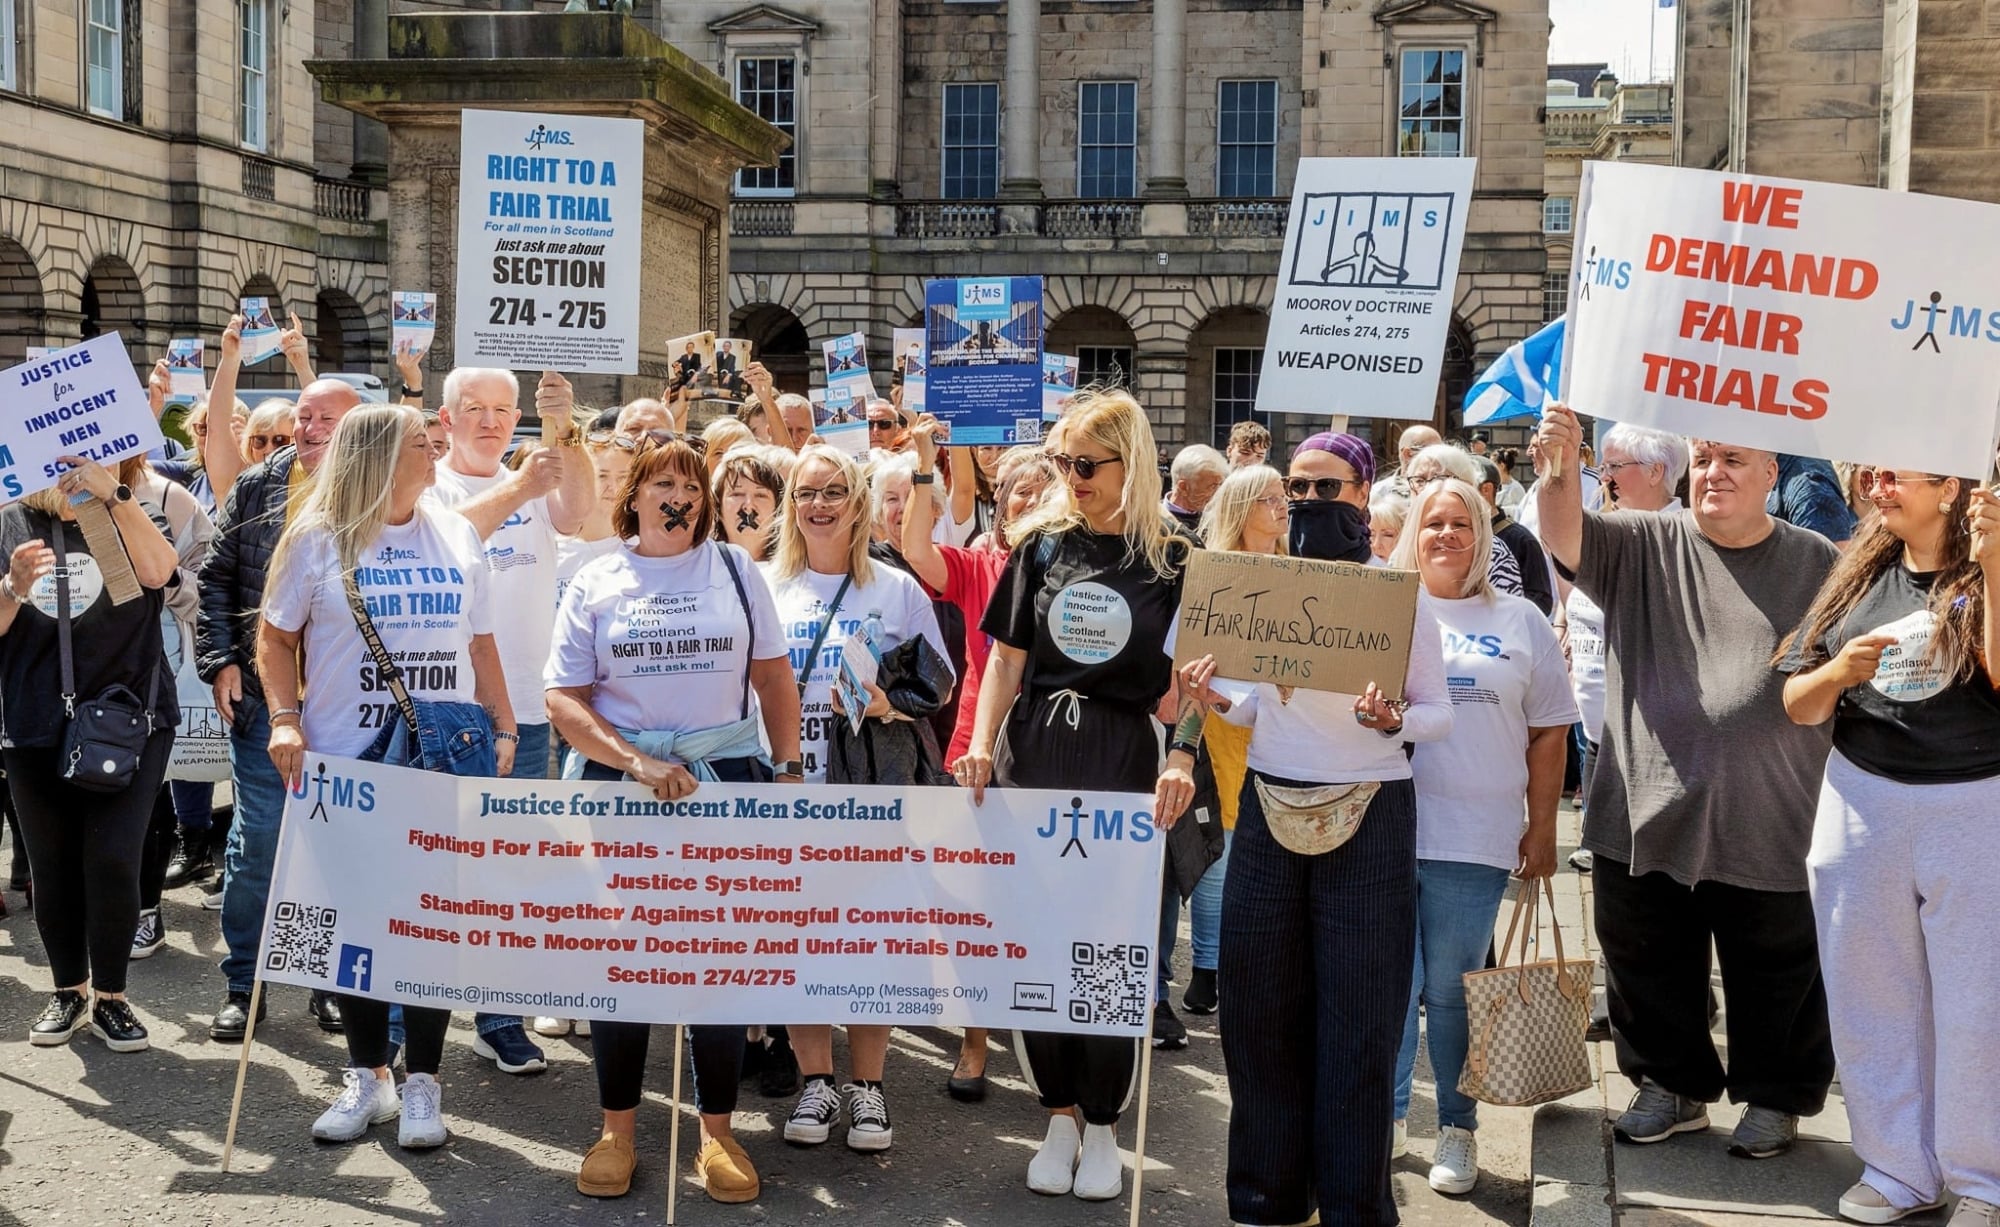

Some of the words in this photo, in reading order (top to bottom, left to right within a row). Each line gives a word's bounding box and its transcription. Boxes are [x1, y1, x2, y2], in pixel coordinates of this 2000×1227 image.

[488, 154, 560, 182] RIGHT
[565, 159, 595, 184] TO
[600, 162, 616, 186] A
[489, 192, 540, 219] FAIR
[546, 195, 612, 222] TRIAL
[1722, 181, 1803, 230] WE
[484, 221, 502, 232] For
[506, 224, 520, 232] all
[523, 226, 547, 234] men
[550, 225, 560, 234] in
[564, 225, 614, 238] Scotland
[495, 238, 521, 252] just
[522, 239, 544, 252] ask
[546, 243, 566, 254] me
[568, 243, 605, 256] about
[493, 256, 605, 288] SECTION
[1645, 234, 1880, 300] DEMAND
[965, 285, 1000, 304] JIMS
[489, 296, 536, 326] 274
[558, 300, 606, 329] 275
[1287, 298, 1352, 312] MOOROV
[1355, 300, 1432, 314] DOCTRINE
[1300, 323, 1350, 338] Articles
[1354, 326, 1381, 340] 274,
[1385, 327, 1410, 340] 275
[1679, 300, 1803, 355] FAIR
[21, 350, 93, 386] JUSTICE
[1278, 351, 1423, 374] WEAPONISED
[54, 383, 75, 402] for
[1642, 352, 1830, 421] TRIALS
[25, 389, 117, 433] INNOCENT
[59, 422, 101, 446] MEN
[417, 567, 446, 584] TO
[449, 568, 464, 584] A
[1212, 553, 1259, 566] JUSTICE
[1270, 558, 1290, 570] FOR
[1378, 571, 1404, 582] MEN
[1066, 589, 1102, 602] Justice
[1105, 594, 1119, 602] for
[366, 594, 402, 618] AIR
[632, 604, 697, 615] Innocent
[1064, 601, 1108, 613] Innocent
[387, 621, 408, 629] men
[412, 620, 420, 628] in
[628, 618, 660, 627] Men
[1062, 613, 1083, 623] Men
[628, 626, 696, 639] Scotland
[1062, 625, 1106, 638] Scotland
[407, 653, 426, 661] me
[427, 650, 456, 661] about
[612, 642, 644, 658] RIGHT
[648, 642, 662, 655] TO
[666, 641, 674, 655] A
[678, 640, 701, 654] FAIR
[704, 637, 733, 652] TRIAL
[633, 664, 661, 673] Just
[665, 662, 687, 672] ask
[691, 660, 714, 669] me!
[1253, 655, 1312, 678] JIMS
[803, 702, 821, 713] ask
[480, 792, 565, 817] Justice
[570, 793, 610, 817] for
[614, 796, 729, 819] Innocent
[734, 798, 788, 820] Men
[792, 797, 903, 822] Scotland
[1037, 796, 1155, 859] JIMS
[408, 829, 485, 858] Fighting
[493, 839, 530, 857] For
[539, 840, 584, 858] Fair
[592, 842, 658, 860] Trials
[681, 844, 793, 865] Exposing
[799, 844, 926, 864] Scotland's
[934, 846, 1016, 865] Broken
[606, 874, 697, 892] Justice
[705, 875, 802, 893] System!
[420, 894, 514, 921] Standing
[520, 902, 625, 923] Together
[631, 904, 726, 925] Against
[733, 907, 840, 928] Wrongful
[846, 907, 993, 929] Convictions,
[388, 919, 460, 945] Misuse
[467, 930, 491, 946] Of
[497, 931, 536, 949] The
[544, 934, 637, 953] Moorov
[645, 936, 749, 955] Doctrine
[753, 938, 798, 954] And
[806, 938, 877, 955] Unfair
[884, 938, 949, 956] Trials
[956, 940, 999, 958] Due
[1004, 942, 1027, 960] To
[606, 967, 696, 985] Section
[704, 969, 796, 987] 274/275
[394, 979, 617, 1013] enquiries@jimsscotland.org
[804, 983, 875, 999] WhatsApp
[879, 984, 950, 1000] (Messages
[953, 985, 988, 1001] Only)
[1020, 992, 1047, 1000] www.
[850, 1001, 893, 1014] 07701
[896, 1001, 944, 1014] 288499
